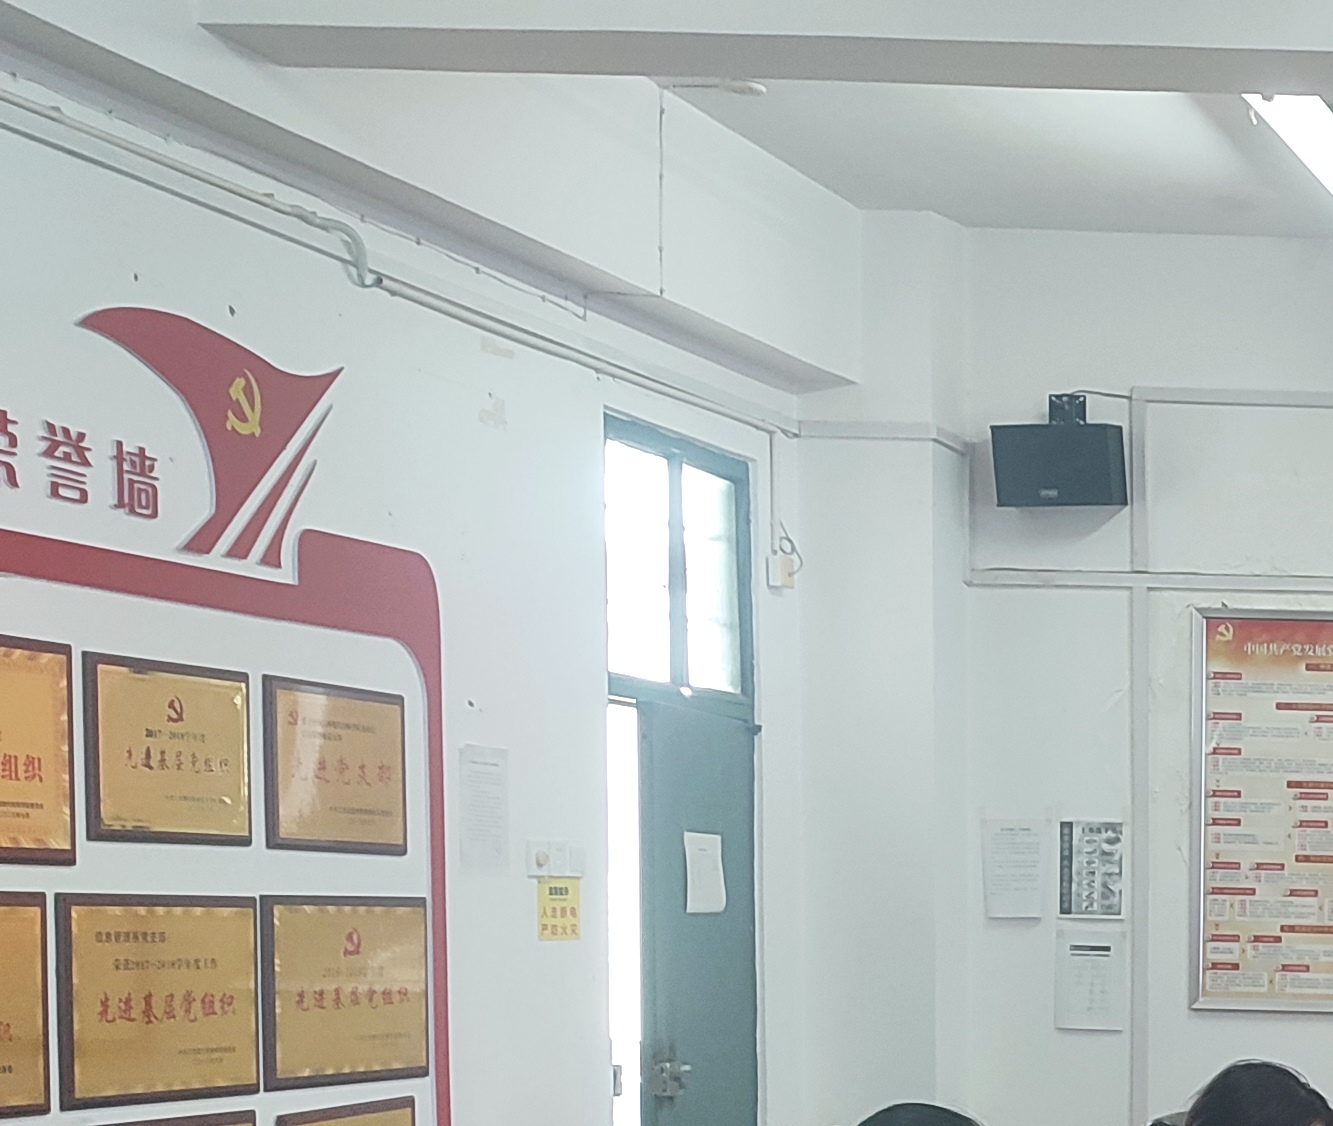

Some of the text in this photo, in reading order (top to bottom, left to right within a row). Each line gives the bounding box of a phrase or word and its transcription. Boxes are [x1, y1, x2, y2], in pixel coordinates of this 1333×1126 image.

[125, 744, 229, 774] 先进基层党组织
[98, 990, 236, 1025] 先进基层党组织
[295, 986, 411, 1012] 先进基层党组织
